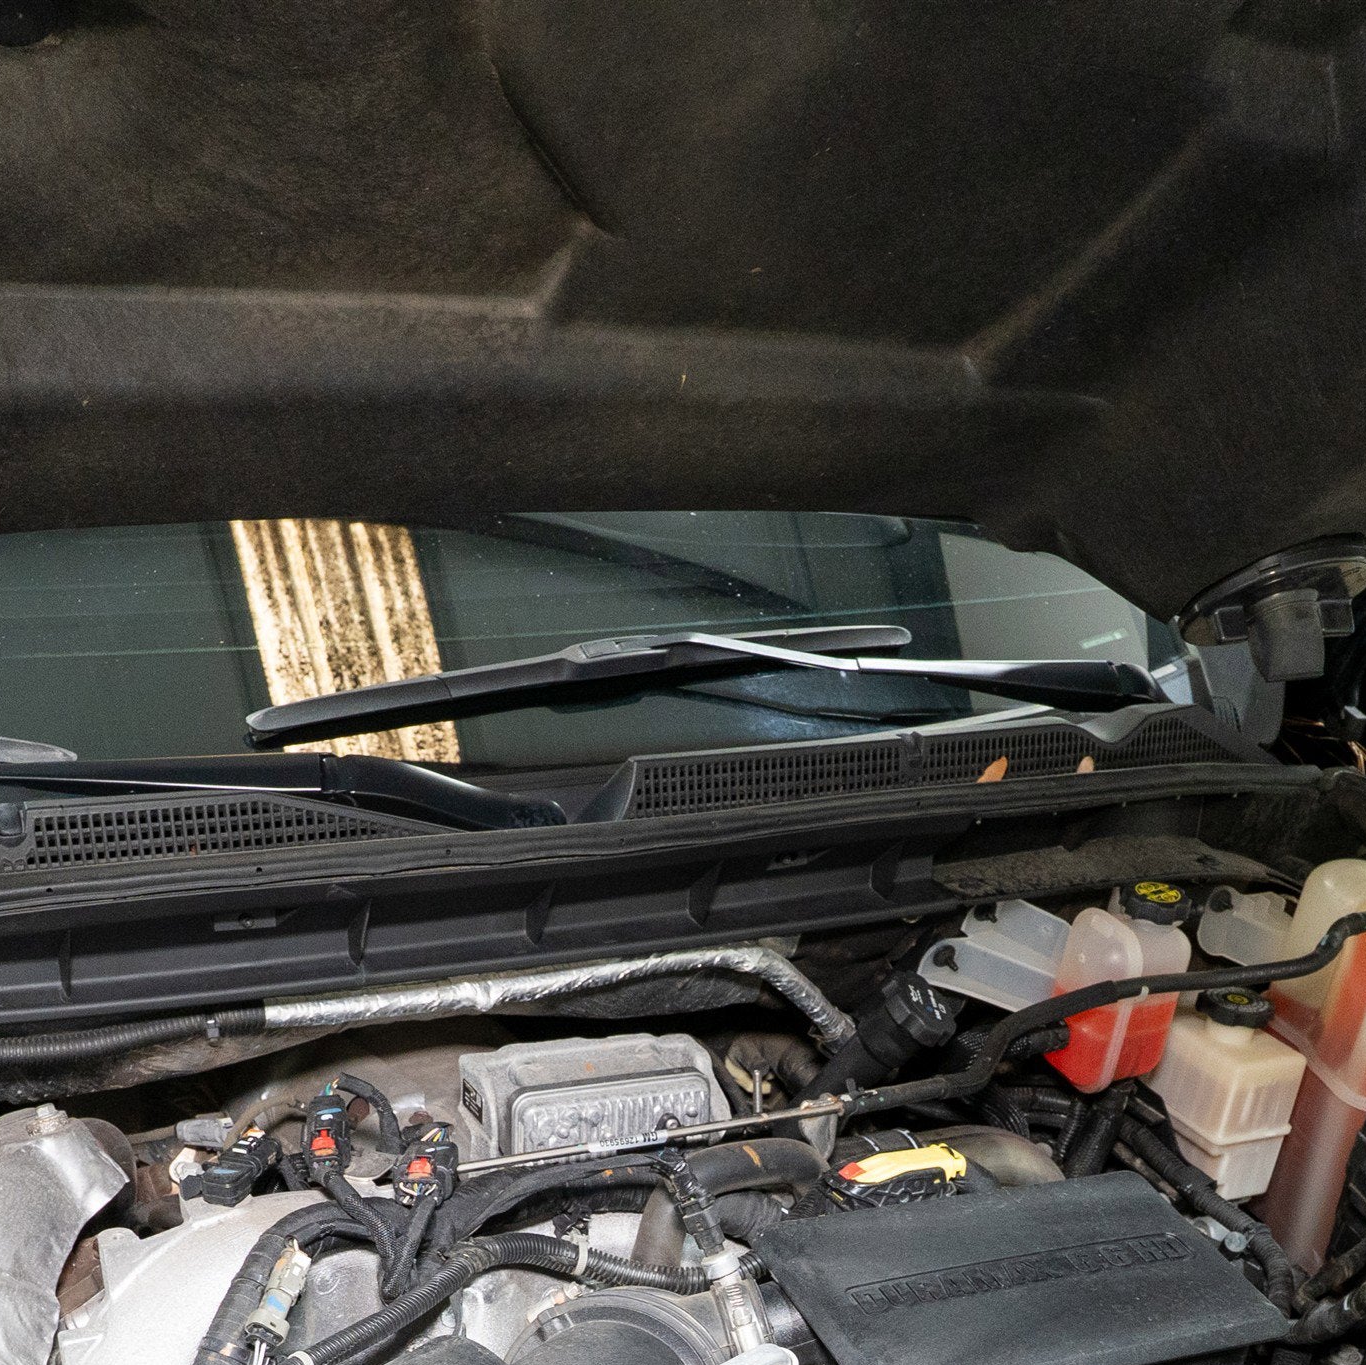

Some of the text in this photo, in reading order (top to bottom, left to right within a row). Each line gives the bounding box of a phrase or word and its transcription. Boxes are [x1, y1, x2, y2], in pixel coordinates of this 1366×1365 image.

[600, 1130, 659, 1147] GM 12695930
[848, 1236, 1186, 1316] DURAMAX 6.6 HD
